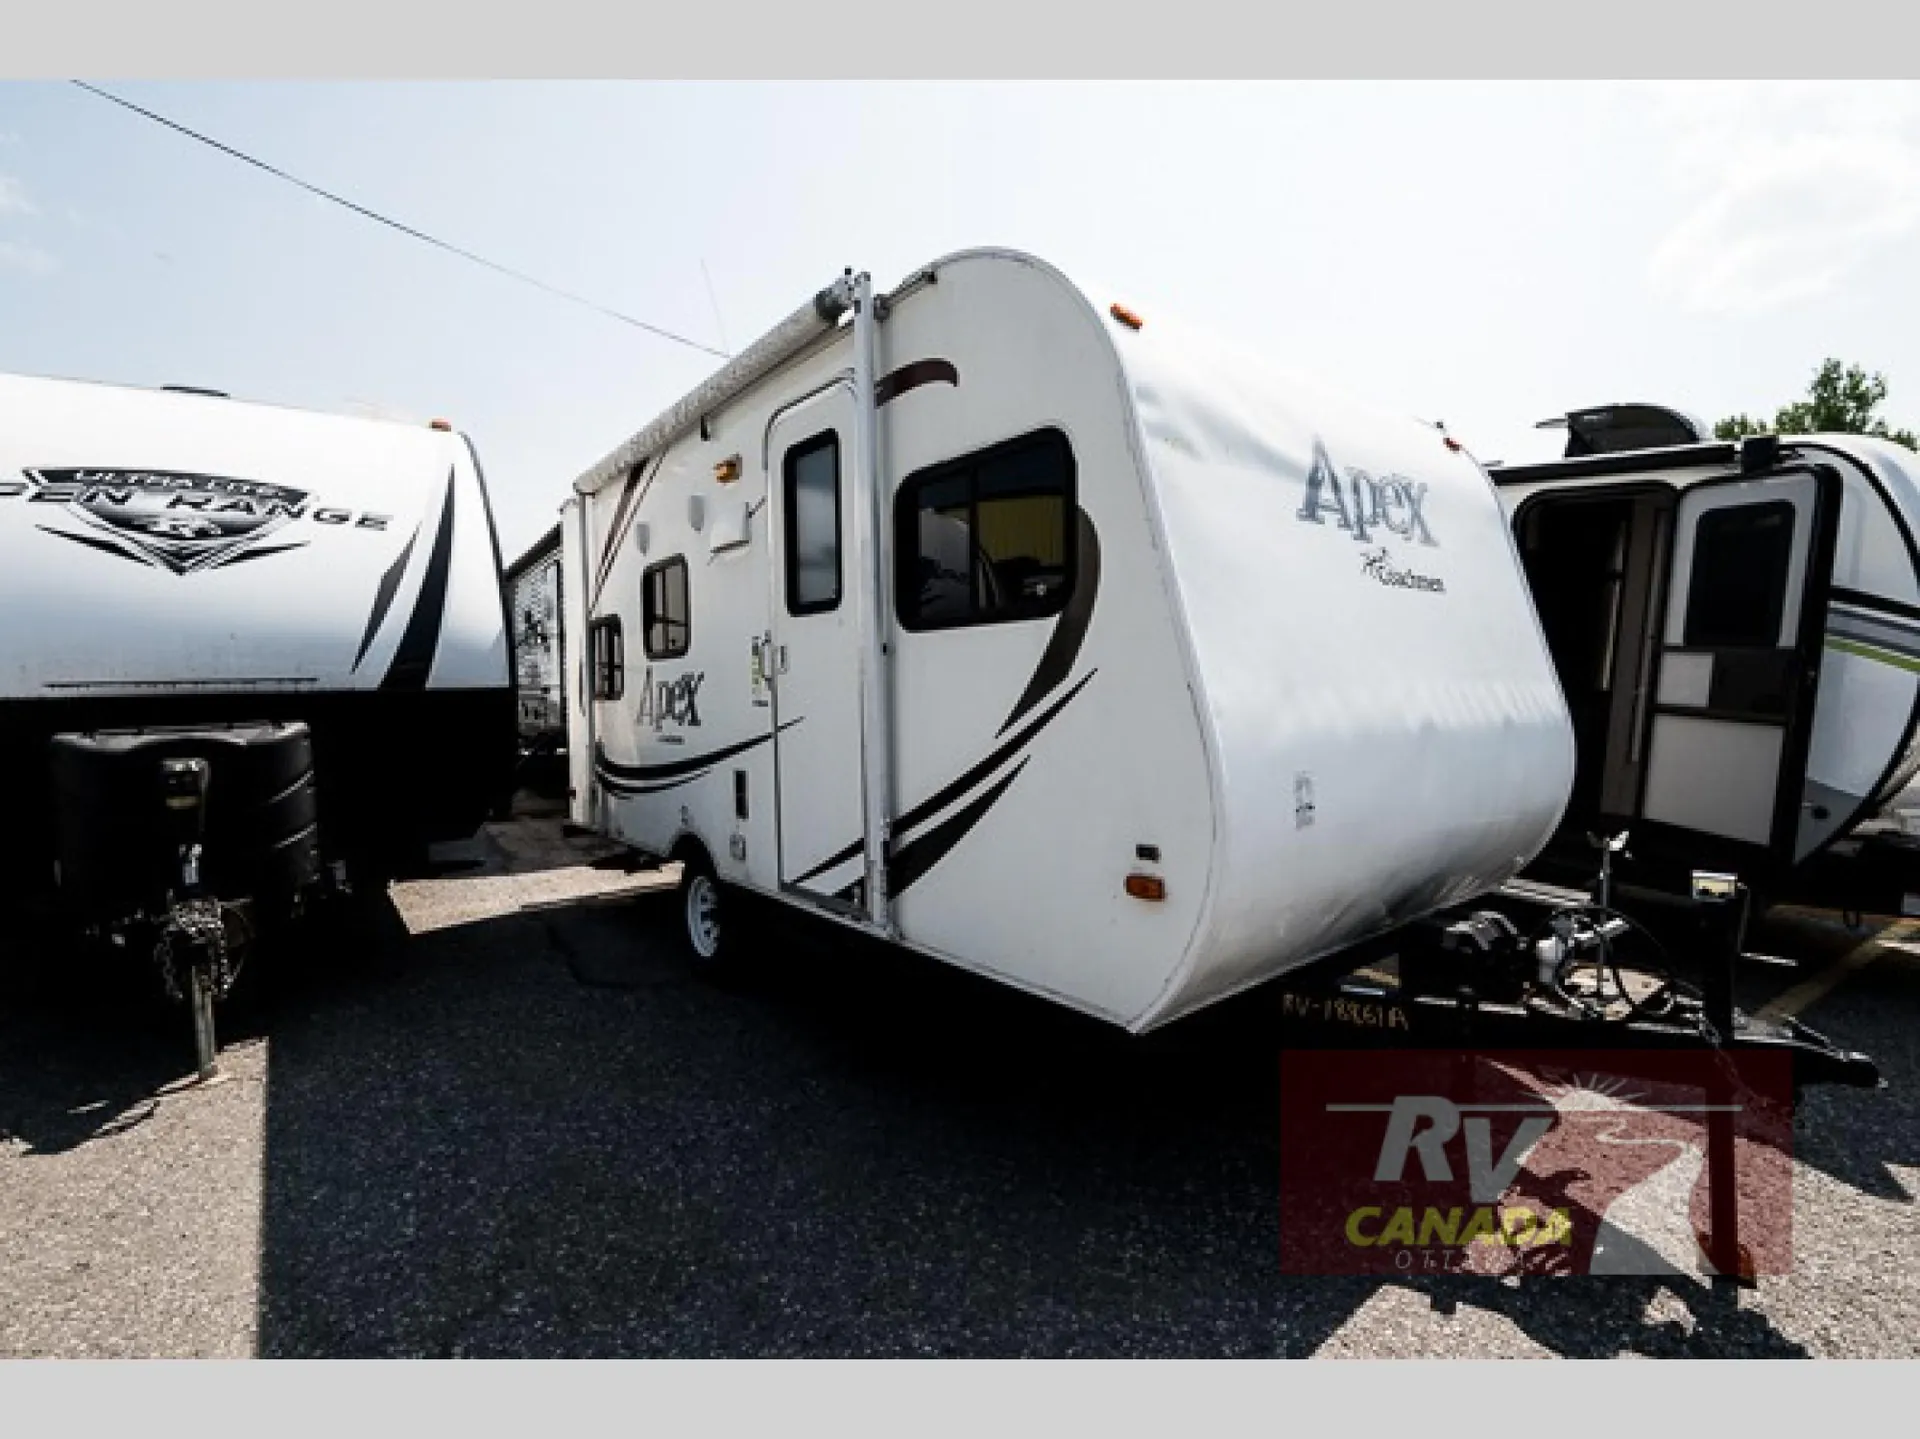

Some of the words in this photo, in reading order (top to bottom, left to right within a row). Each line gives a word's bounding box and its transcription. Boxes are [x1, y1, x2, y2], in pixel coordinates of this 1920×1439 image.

[165, 491, 394, 531] RANGE
[1296, 434, 1439, 546] Apex
[636, 665, 705, 732] Apex
